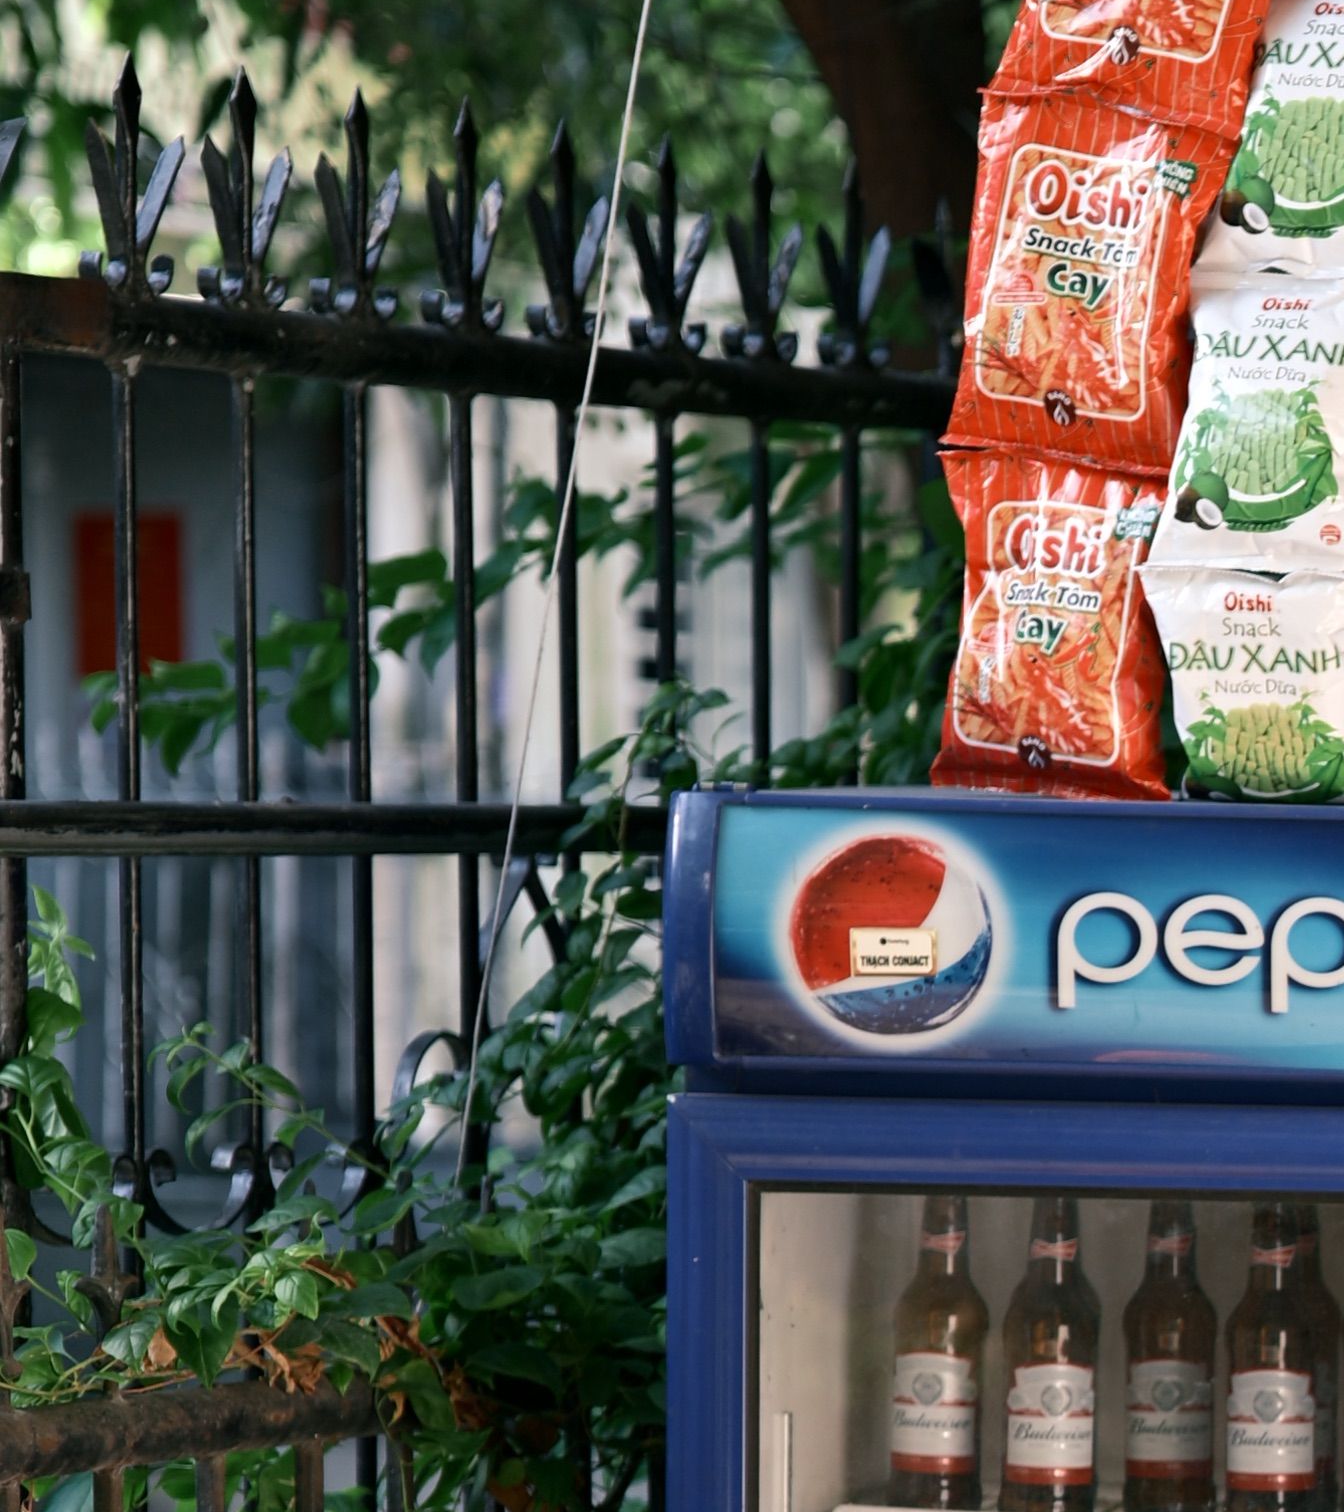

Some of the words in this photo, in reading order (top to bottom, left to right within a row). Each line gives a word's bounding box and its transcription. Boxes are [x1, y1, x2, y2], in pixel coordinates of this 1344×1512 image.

[1028, 161, 1148, 231] Oishi
[1024, 227, 1096, 258] Snack
[1046, 262, 1110, 308] Cay
[1262, 297, 1312, 312] Oishi
[1252, 314, 1310, 330] Snack
[1008, 515, 1103, 575] Oshi
[1056, 586, 1099, 609] Tôm
[1223, 591, 1274, 613] Oishi
[1222, 617, 1282, 638] Snack
[1169, 640, 1235, 671] ĐẬU
[1242, 644, 1341, 675] XANH
[1229, 1426, 1312, 1450] Budweiser
